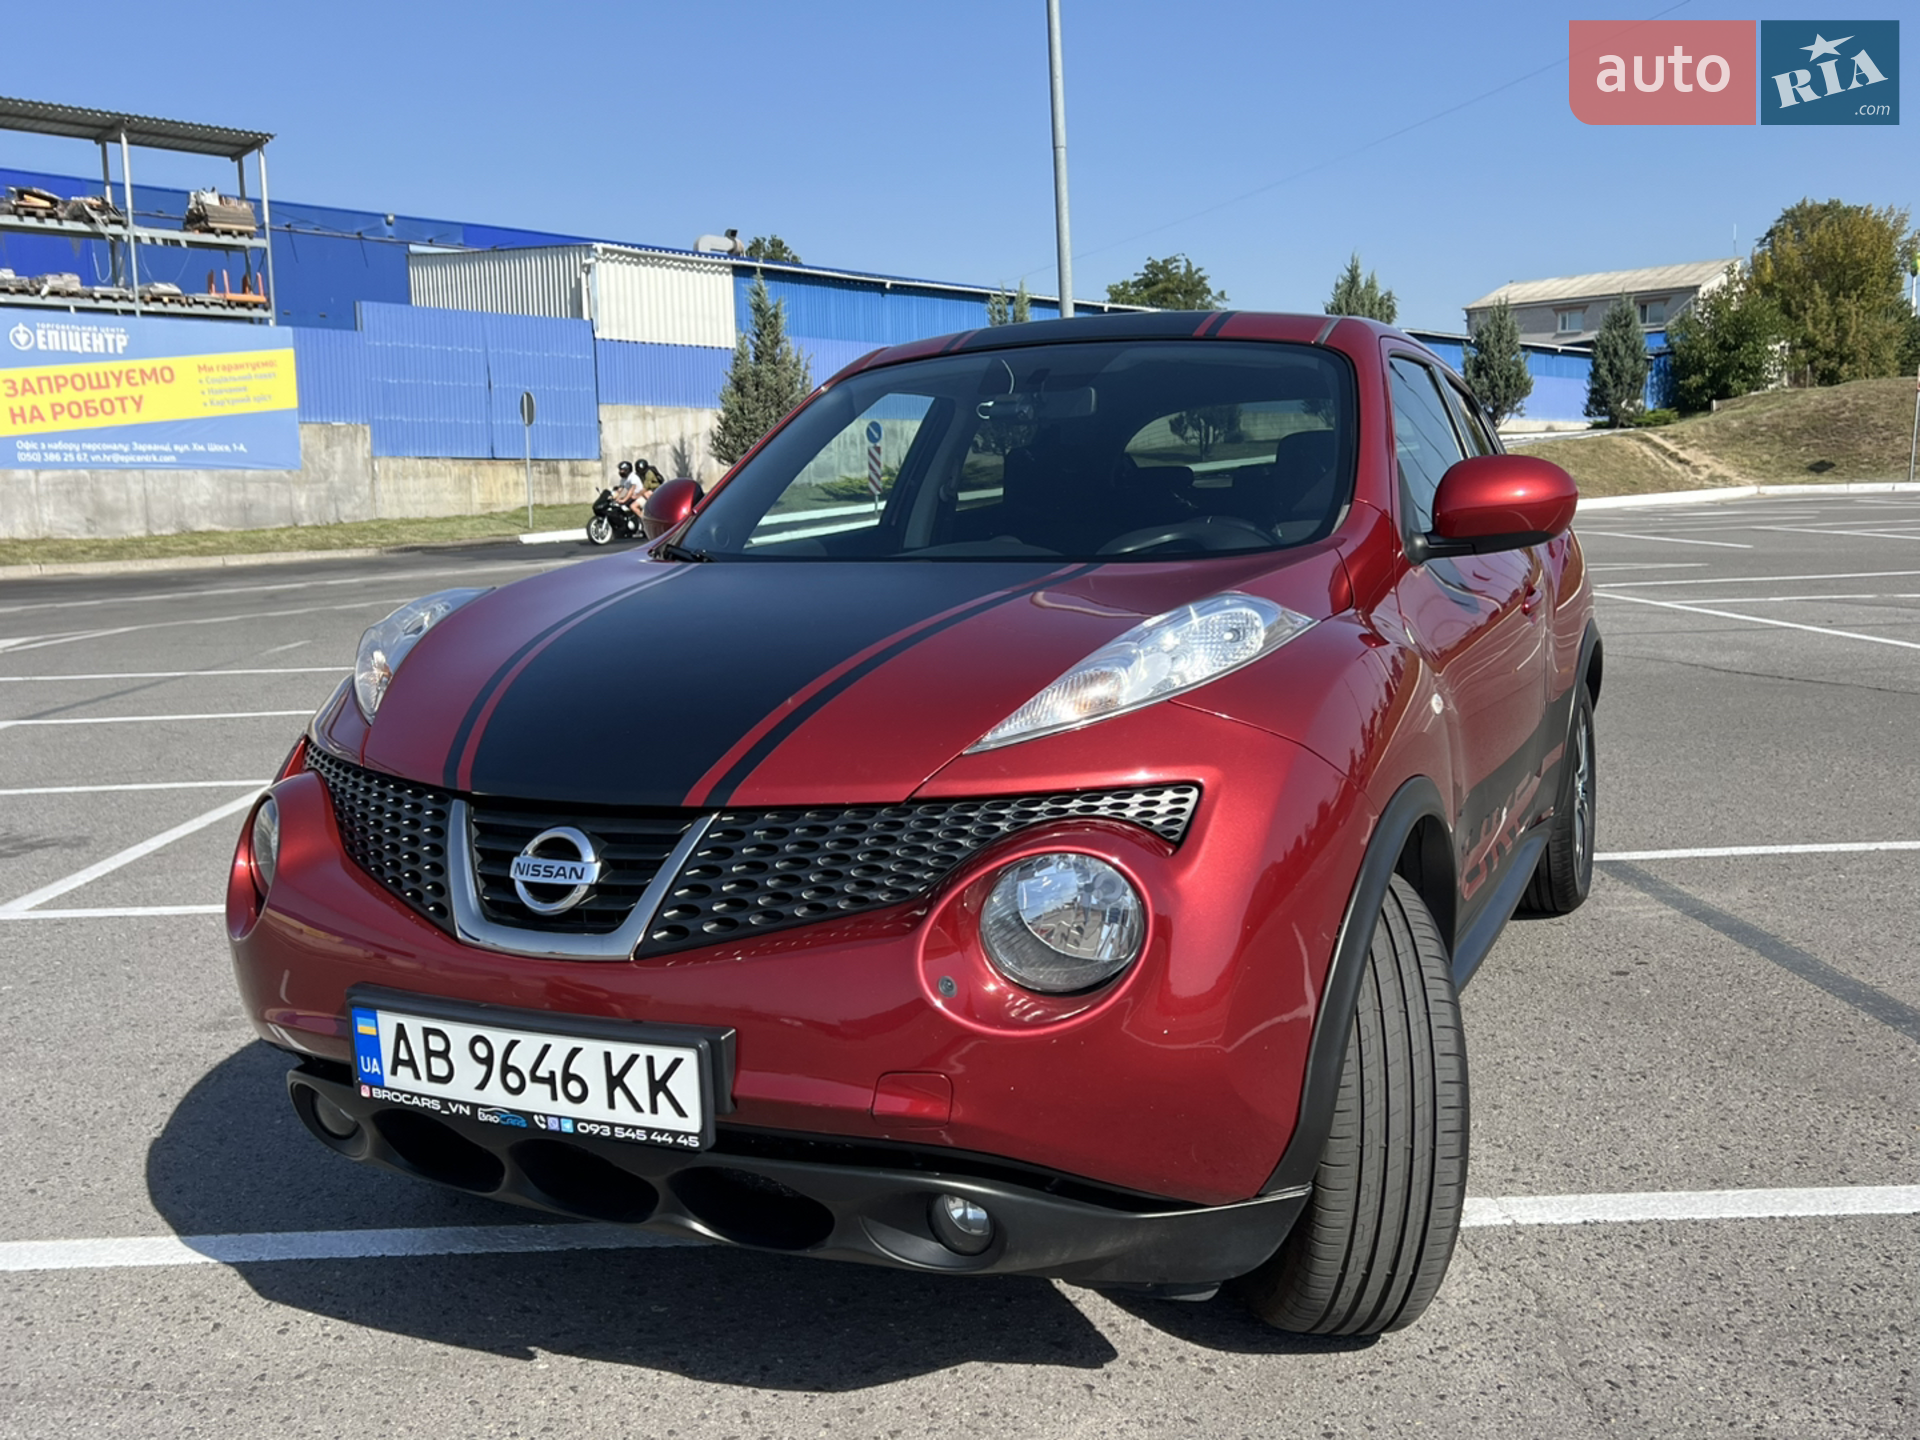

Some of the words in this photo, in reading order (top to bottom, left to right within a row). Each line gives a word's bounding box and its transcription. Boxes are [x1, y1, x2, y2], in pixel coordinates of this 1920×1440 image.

[36, 329, 129, 354] ЕПІЦЕНТР
[197, 363, 214, 373] Ми
[2, 365, 175, 398] ЗАПРОШУЄМО
[8, 404, 46, 425] НА
[50, 394, 144, 422] РОБОТУ
[16, 440, 39, 451] Офіс
[47, 440, 80, 452] набору
[514, 862, 585, 880] NISSAN
[360, 1055, 381, 1075] UA
[390, 1022, 455, 1085] AB
[468, 1034, 589, 1105] 9646
[603, 1051, 689, 1119] KK
[371, 1086, 471, 1116] BROCARS_VN
[576, 1122, 611, 1136] 093
[614, 1126, 648, 1141] 545
[650, 1131, 674, 1145] 44
[676, 1135, 700, 1148] 45
